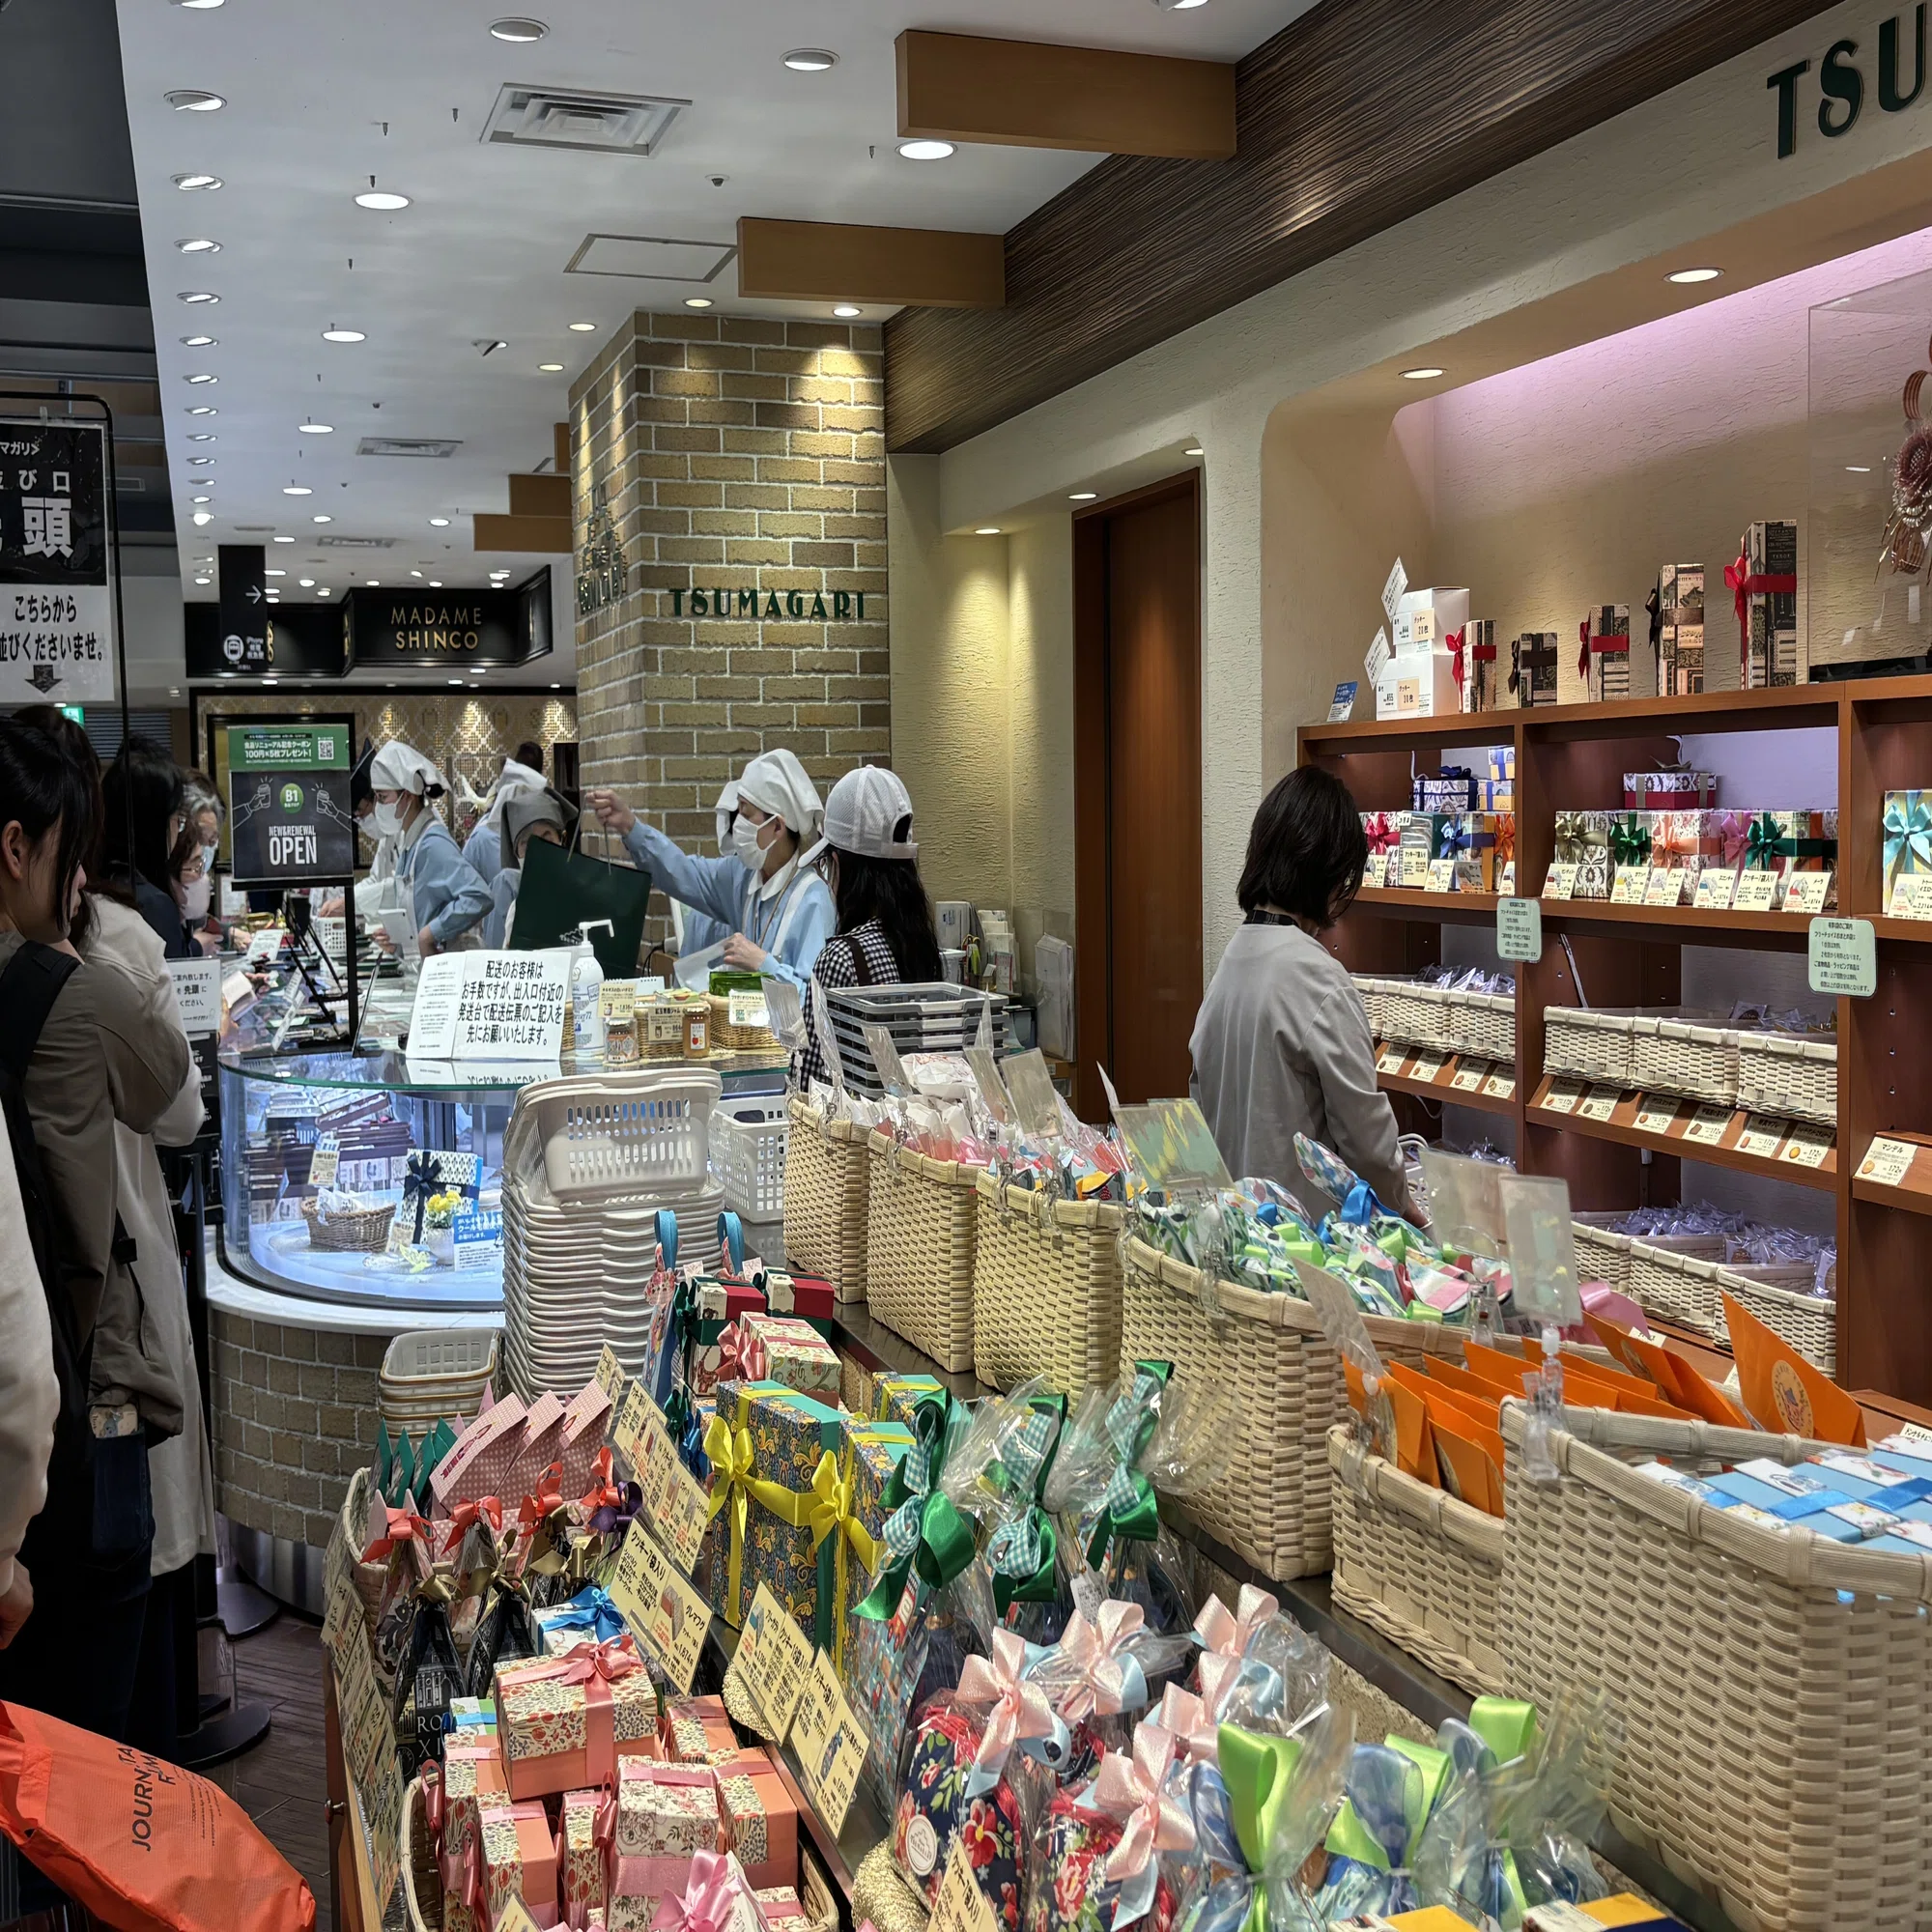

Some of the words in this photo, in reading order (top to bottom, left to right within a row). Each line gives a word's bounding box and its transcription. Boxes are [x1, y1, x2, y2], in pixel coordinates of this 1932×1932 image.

[1767, 3, 1926, 159] TSU
[0, 469, 70, 493] び口
[0, 497, 73, 558] 頭
[14, 595, 77, 623] こちらから
[669, 588, 864, 618] TSUMAGARI
[391, 607, 482, 626] MADAME
[395, 630, 478, 651] SHINCO
[285, 789, 298, 802] B1
[269, 825, 316, 838] NEW&RENEWAL
[270, 837, 317, 866] OPEN
[485, 960, 544, 980] 配送のお客様は
[461, 980, 564, 1003] お手数ですが、出入口付近の
[457, 1002, 563, 1025] 発送台で配送伝票のご記入を
[466, 1024, 548, 1046] 先にお願いいたします。
[417, 1714, 441, 1733] RO
[132, 1764, 154, 1852] JOURN
